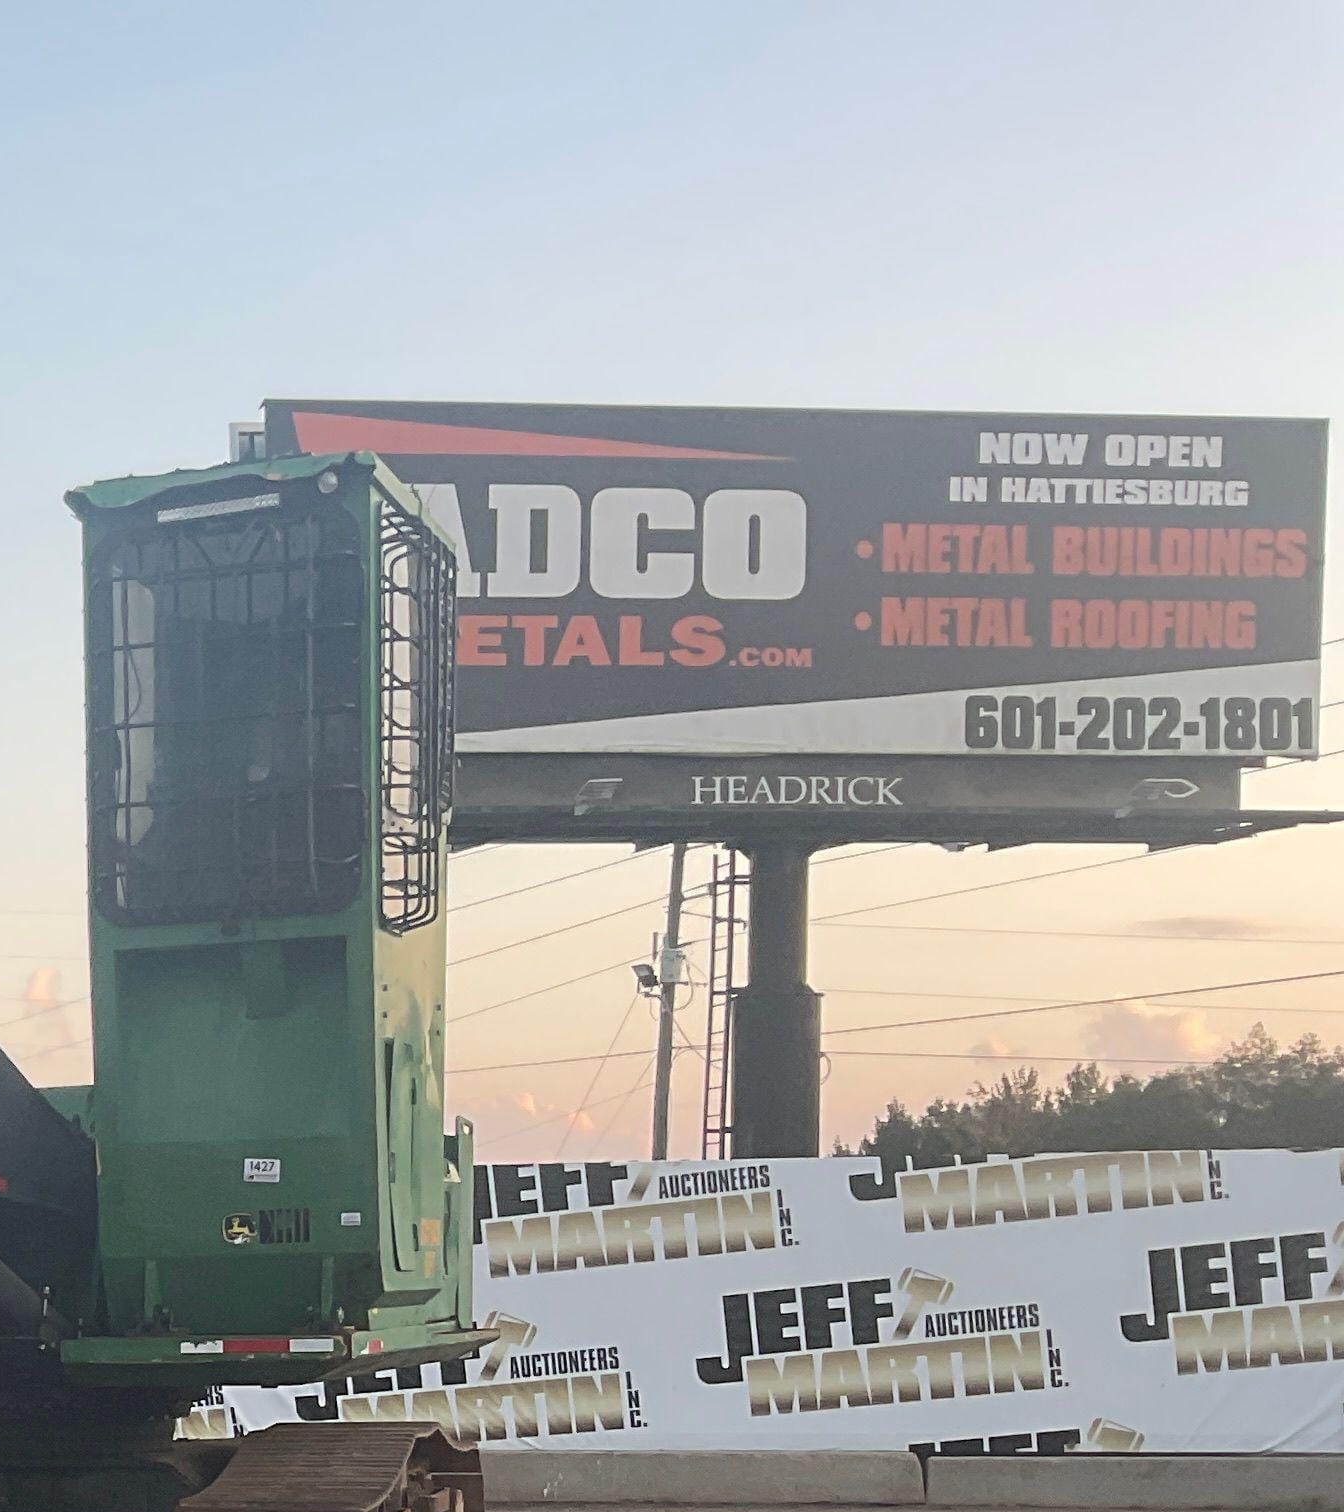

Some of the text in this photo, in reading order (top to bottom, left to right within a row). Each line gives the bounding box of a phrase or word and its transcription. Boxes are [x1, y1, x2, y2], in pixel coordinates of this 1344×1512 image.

[978, 432, 1223, 468] NOW OPEN
[949, 476, 1249, 506] IN HATTIESBURG
[881, 523, 1308, 578] METAL BUILDINGS
[456, 615, 812, 667] ETALS.COM
[880, 597, 1256, 649] METAL ROOFING
[965, 695, 1313, 751] 601-202-1801
[691, 776, 904, 806] HEADRICK
[250, 1161, 275, 1172] 1427
[658, 1165, 771, 1199] AUCTIONEERS
[899, 1151, 1204, 1234] MARTIN
[473, 1163, 627, 1245] EFF
[486, 1191, 776, 1278] MARTIN
[1120, 1232, 1328, 1342] JEFF
[696, 1278, 894, 1384] JEFF
[925, 1304, 1040, 1338] AUCTIONEERS
[510, 1347, 620, 1379] AUCTIONEERS
[746, 1331, 1045, 1416] MARTIN
